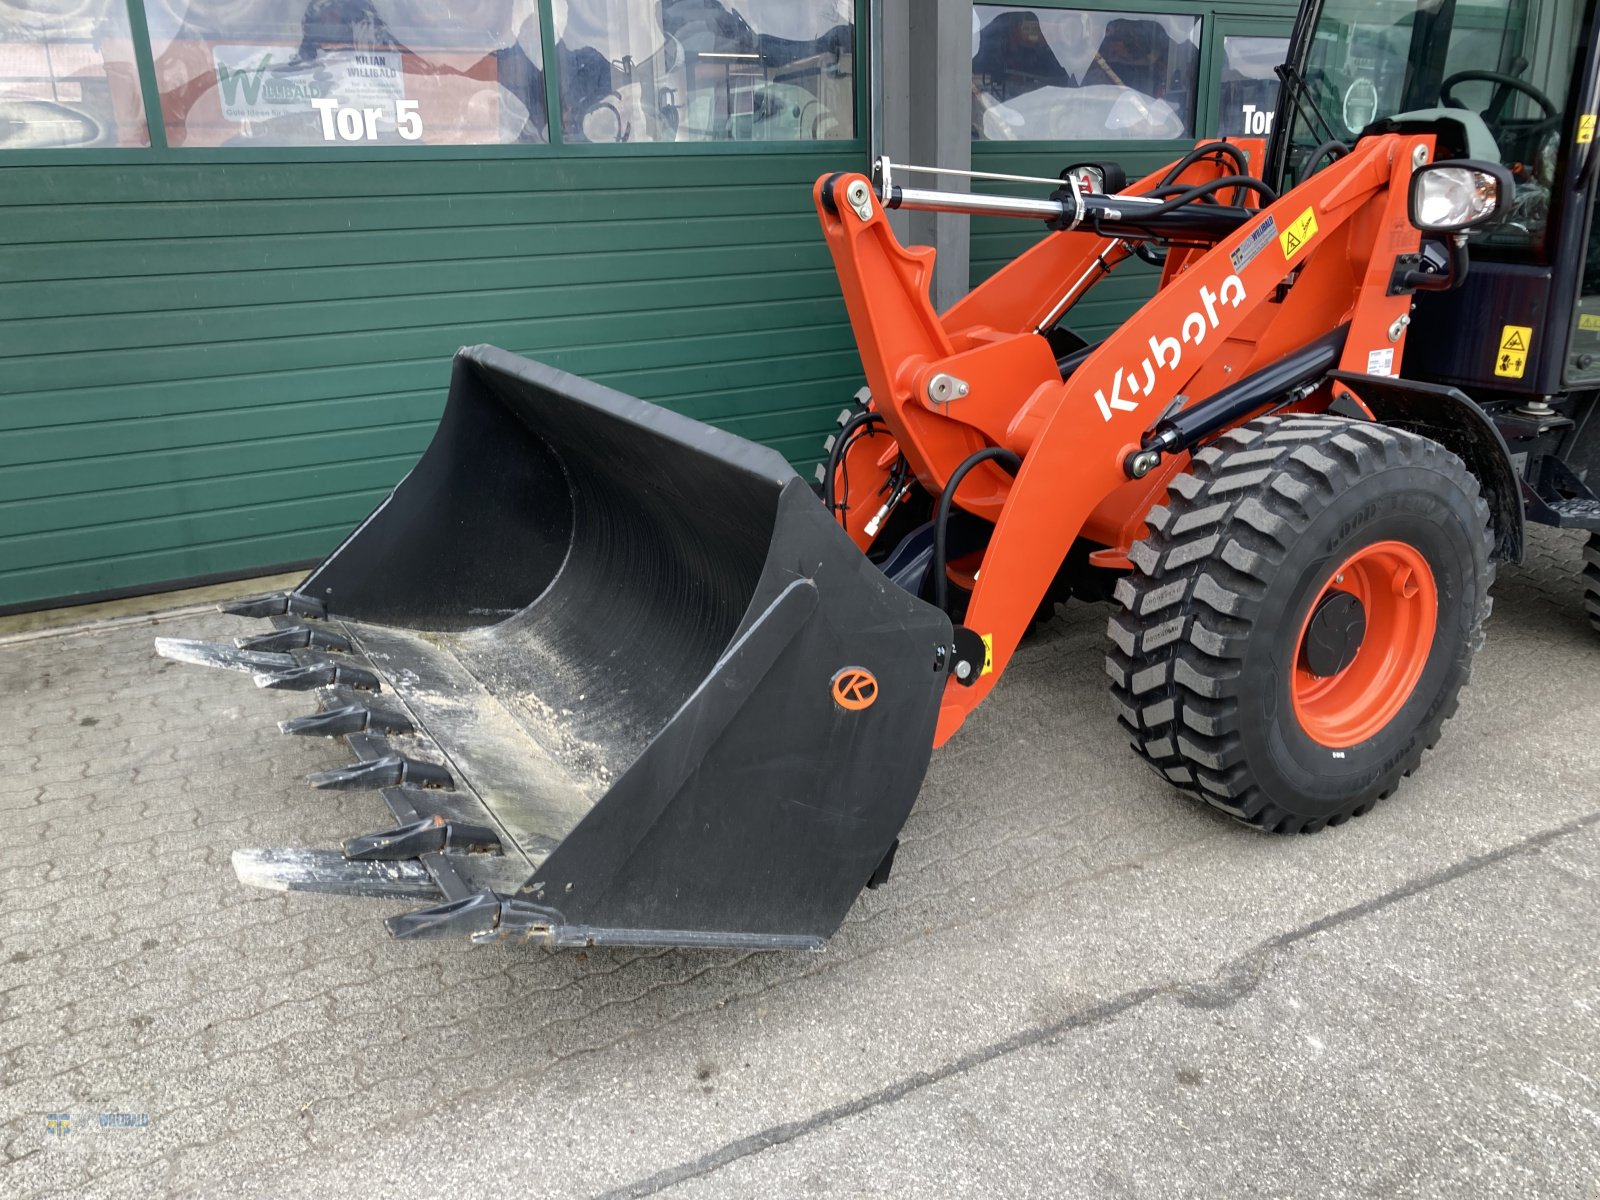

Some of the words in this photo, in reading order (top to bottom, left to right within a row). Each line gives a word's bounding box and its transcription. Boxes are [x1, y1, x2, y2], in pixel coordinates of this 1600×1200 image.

[347, 68, 397, 78] WILLIBALD
[355, 55, 386, 66] KILIAN
[311, 98, 382, 141] Tor
[395, 99, 424, 140] 5
[1242, 104, 1275, 135] Tor
[1093, 274, 1247, 423] Kubota
